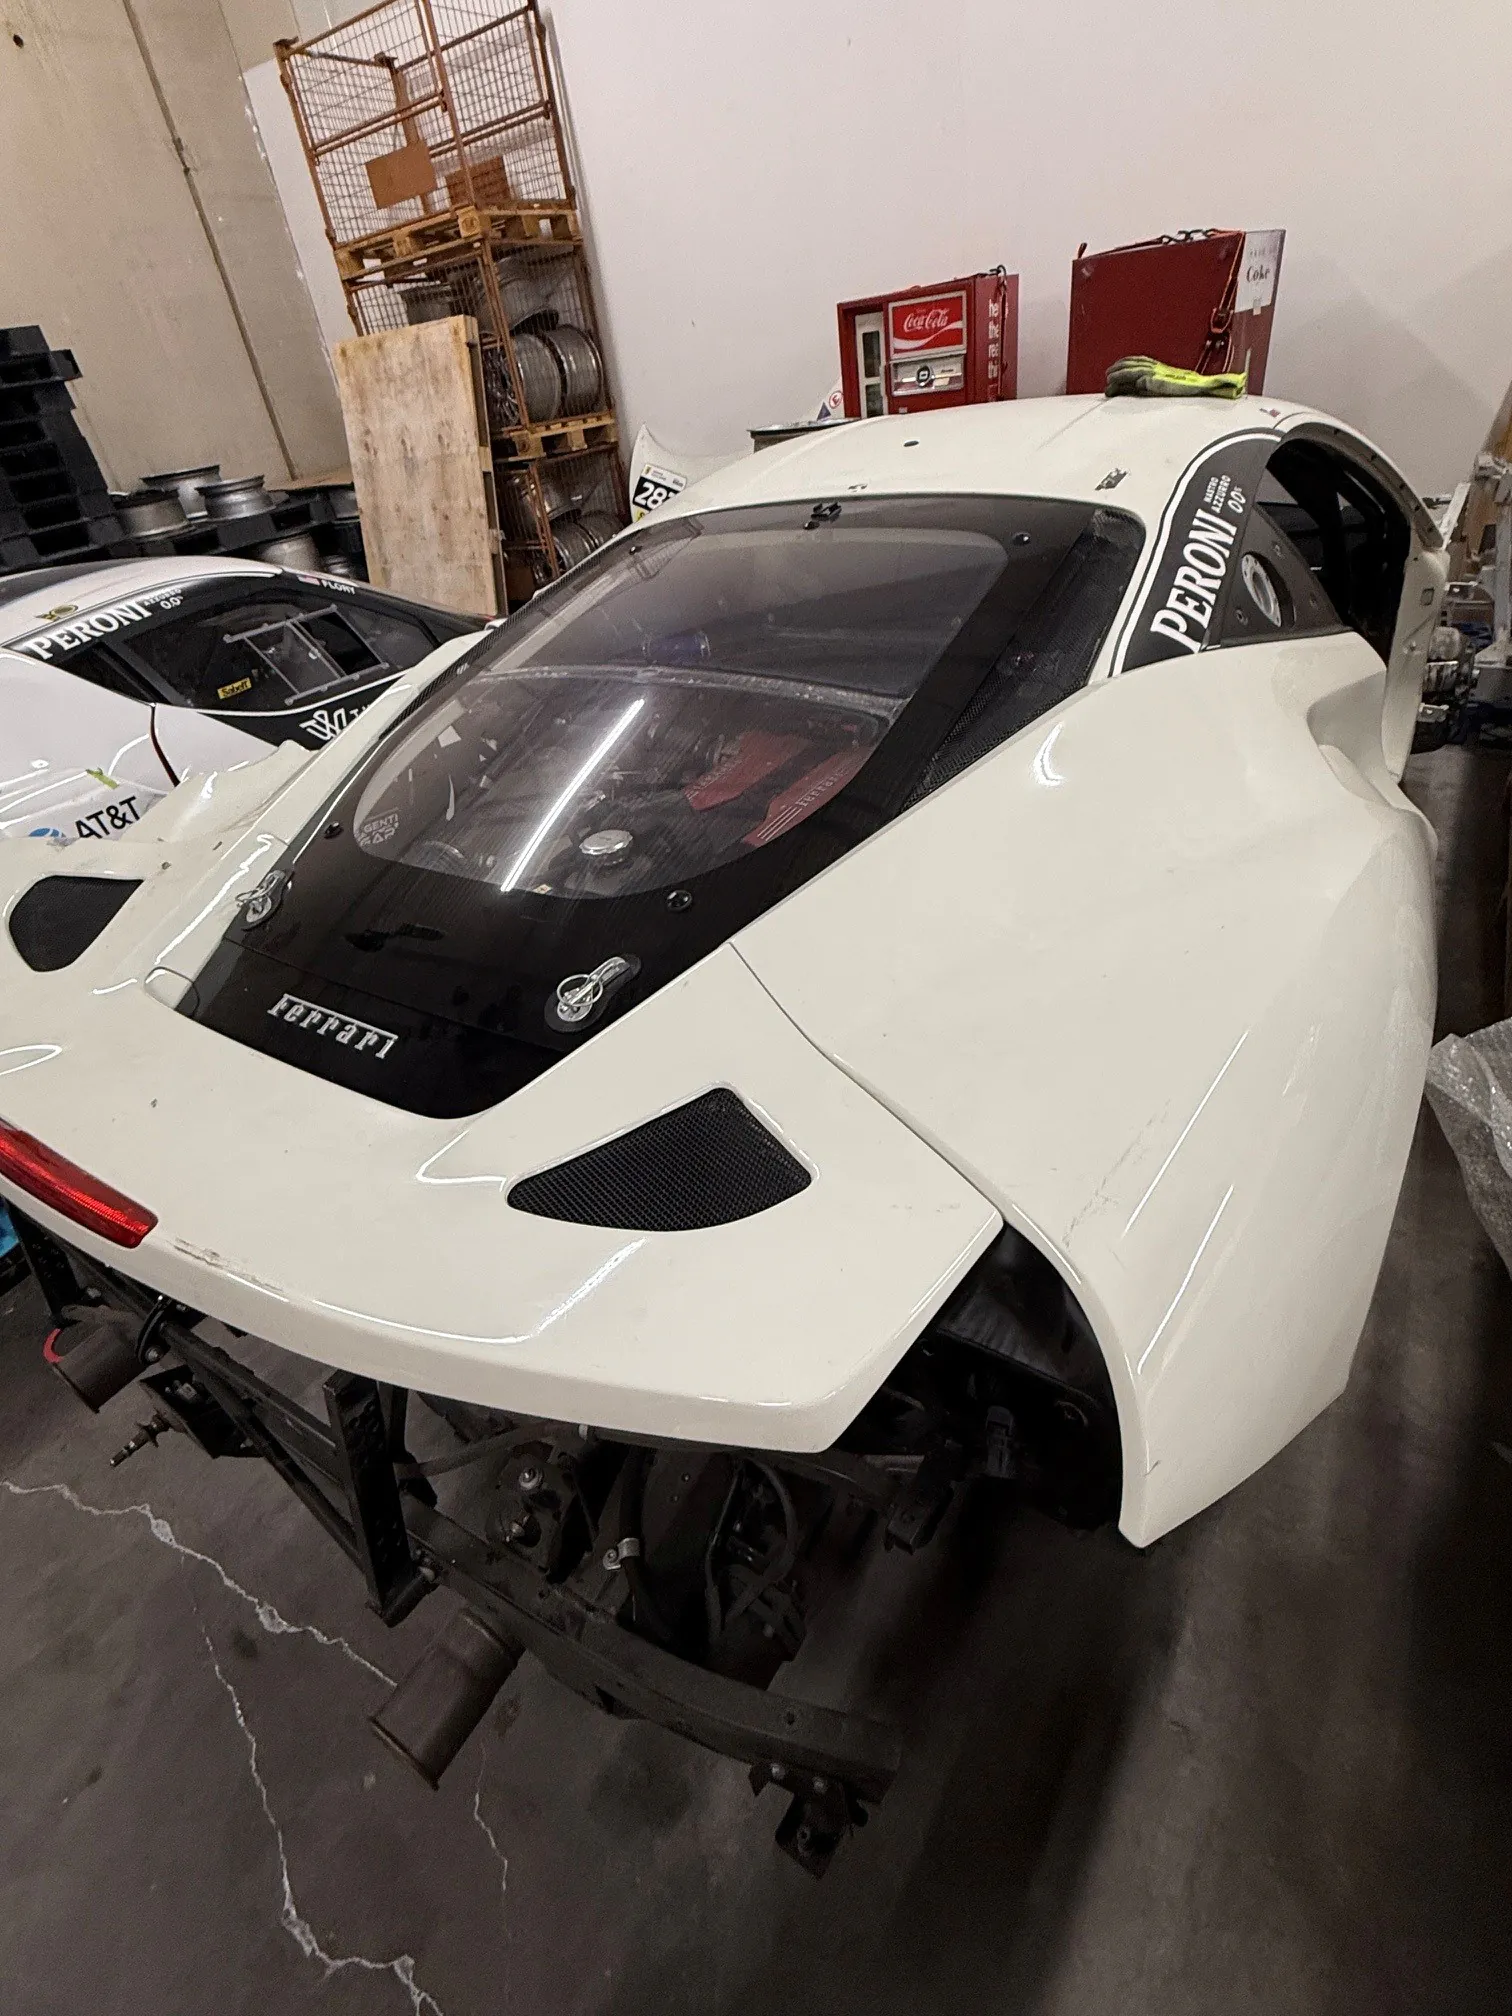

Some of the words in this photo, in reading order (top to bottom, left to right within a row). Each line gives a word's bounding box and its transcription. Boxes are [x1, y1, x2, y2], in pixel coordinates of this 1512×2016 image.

[904, 308, 950, 333] Coca-Cola
[1150, 508, 1238, 654] PERONI
[24, 599, 153, 660] PERONI
[75, 795, 141, 839] AT&T
[267, 993, 399, 1059] Ferrari
